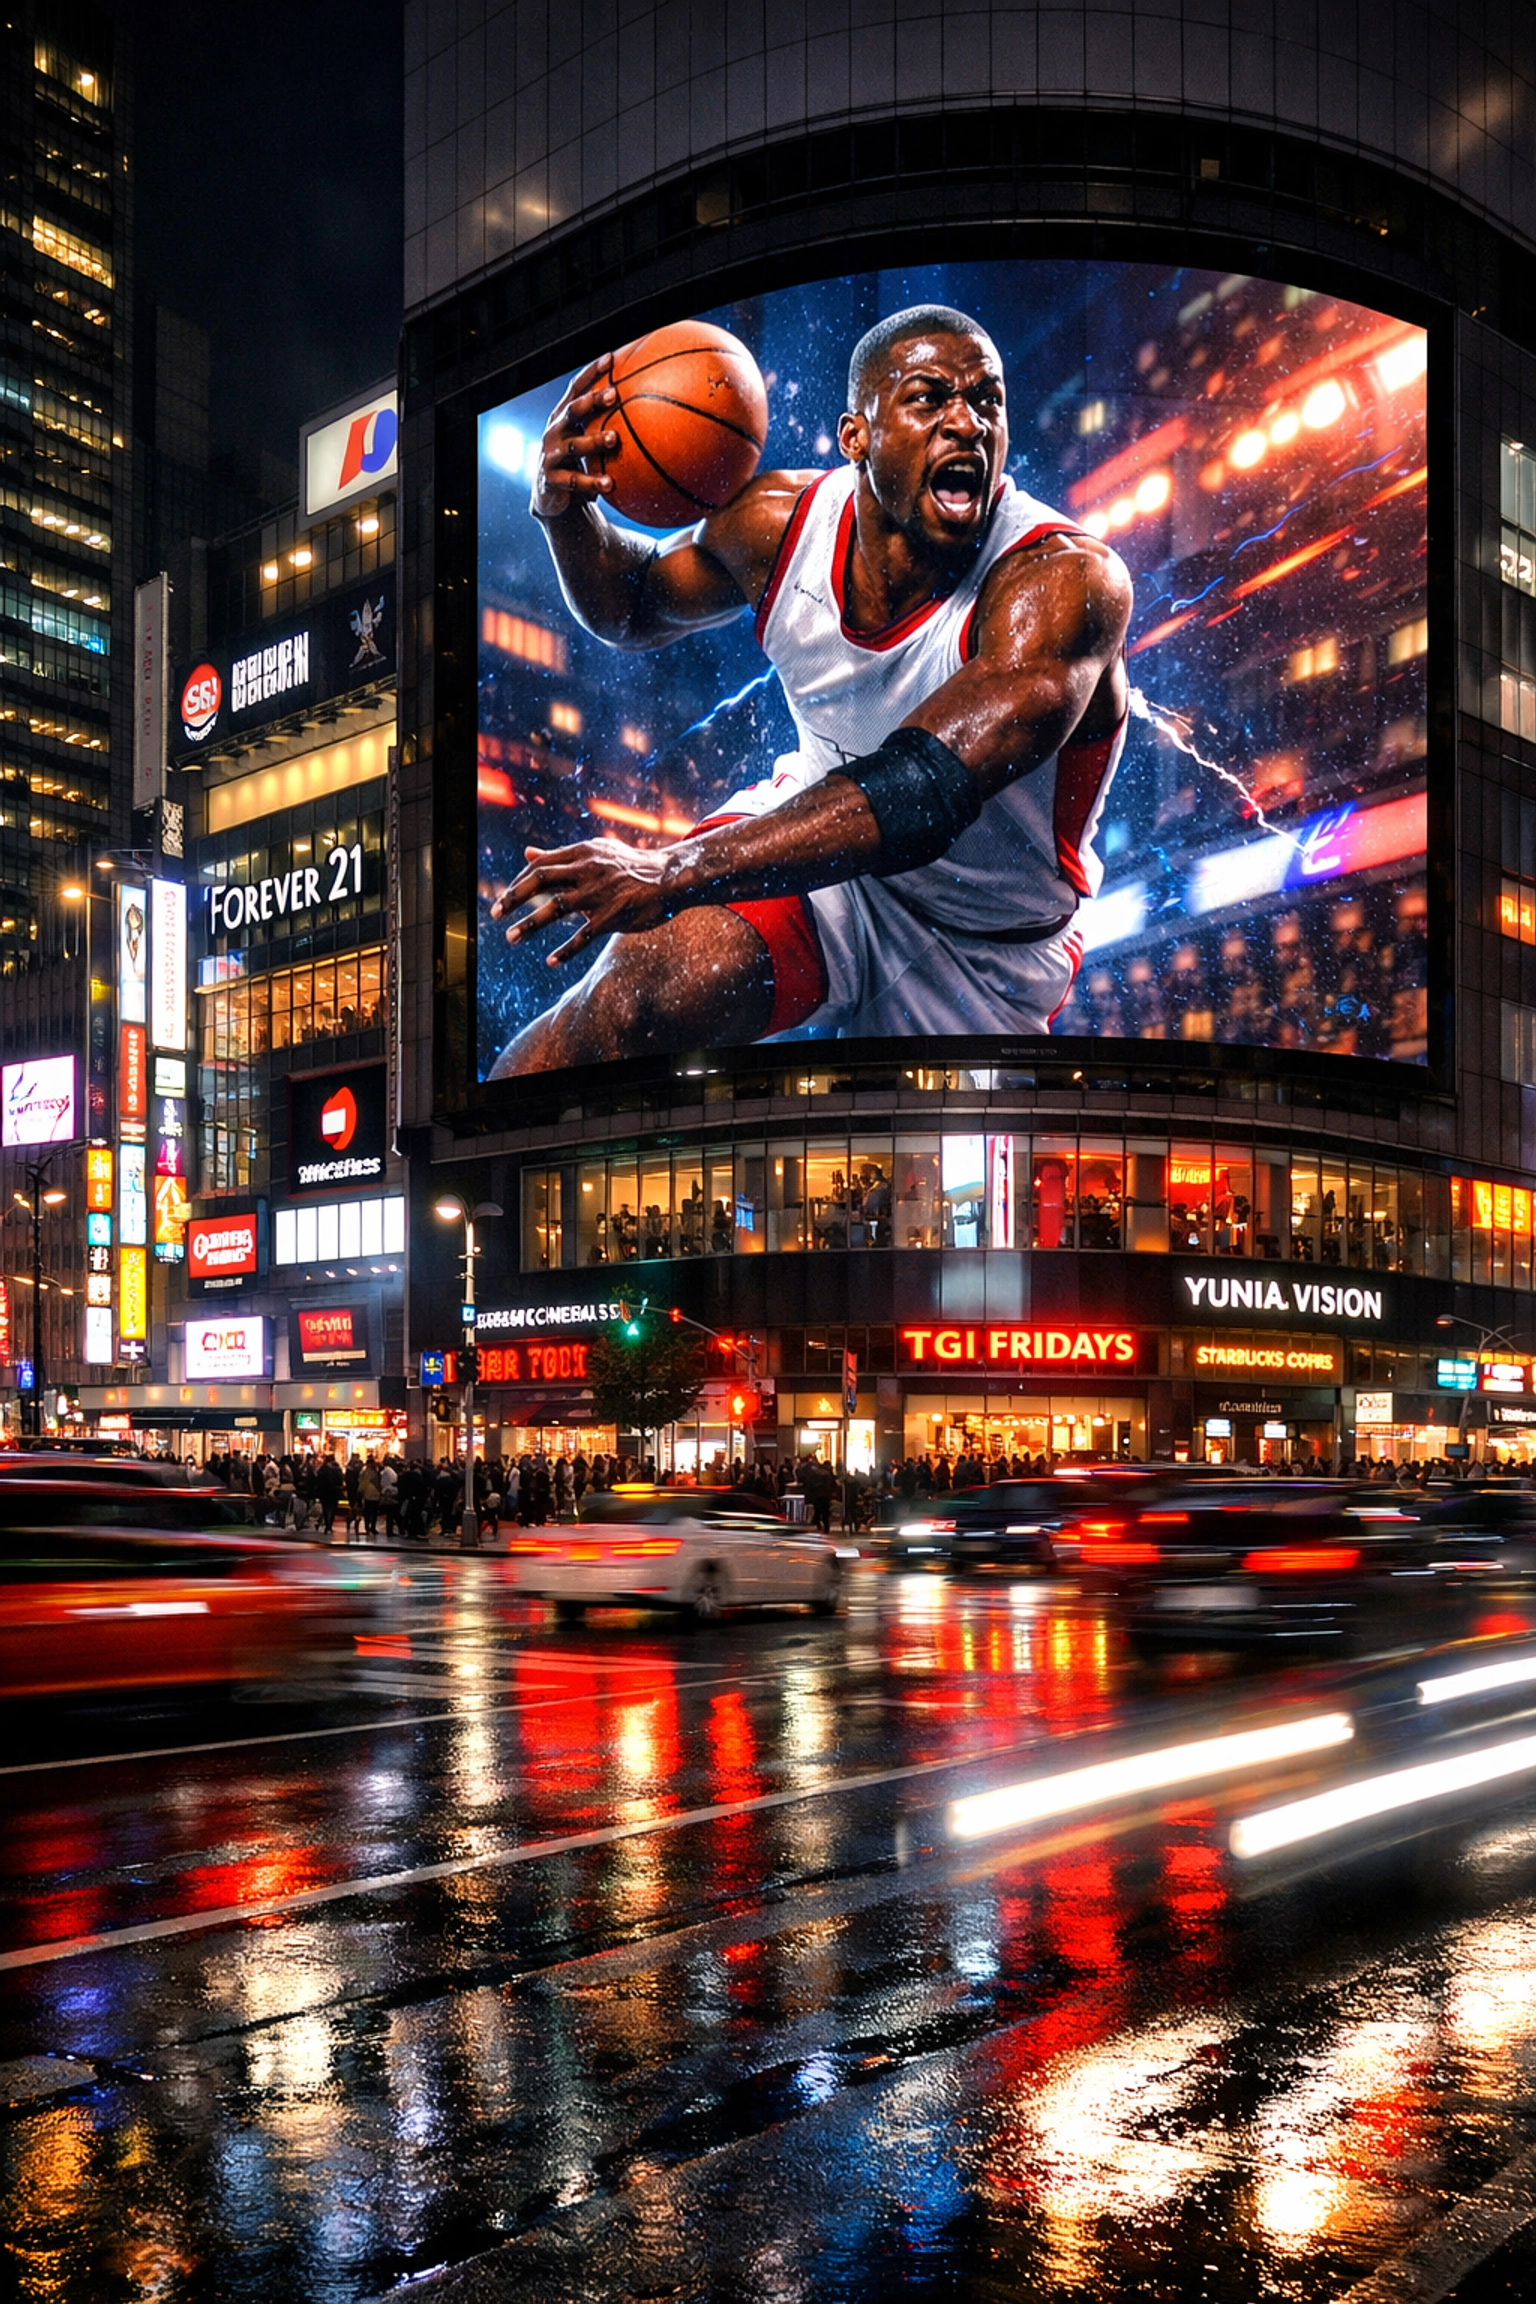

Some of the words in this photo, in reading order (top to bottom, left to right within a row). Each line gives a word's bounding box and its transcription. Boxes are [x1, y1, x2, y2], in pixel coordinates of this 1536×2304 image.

[211, 867, 321, 935] FOREVER
[328, 843, 362, 901] 21
[1292, 1284, 1382, 1319] VISION
[903, 1330, 975, 1360] TGI
[989, 1331, 1134, 1361] FRIDAYS
